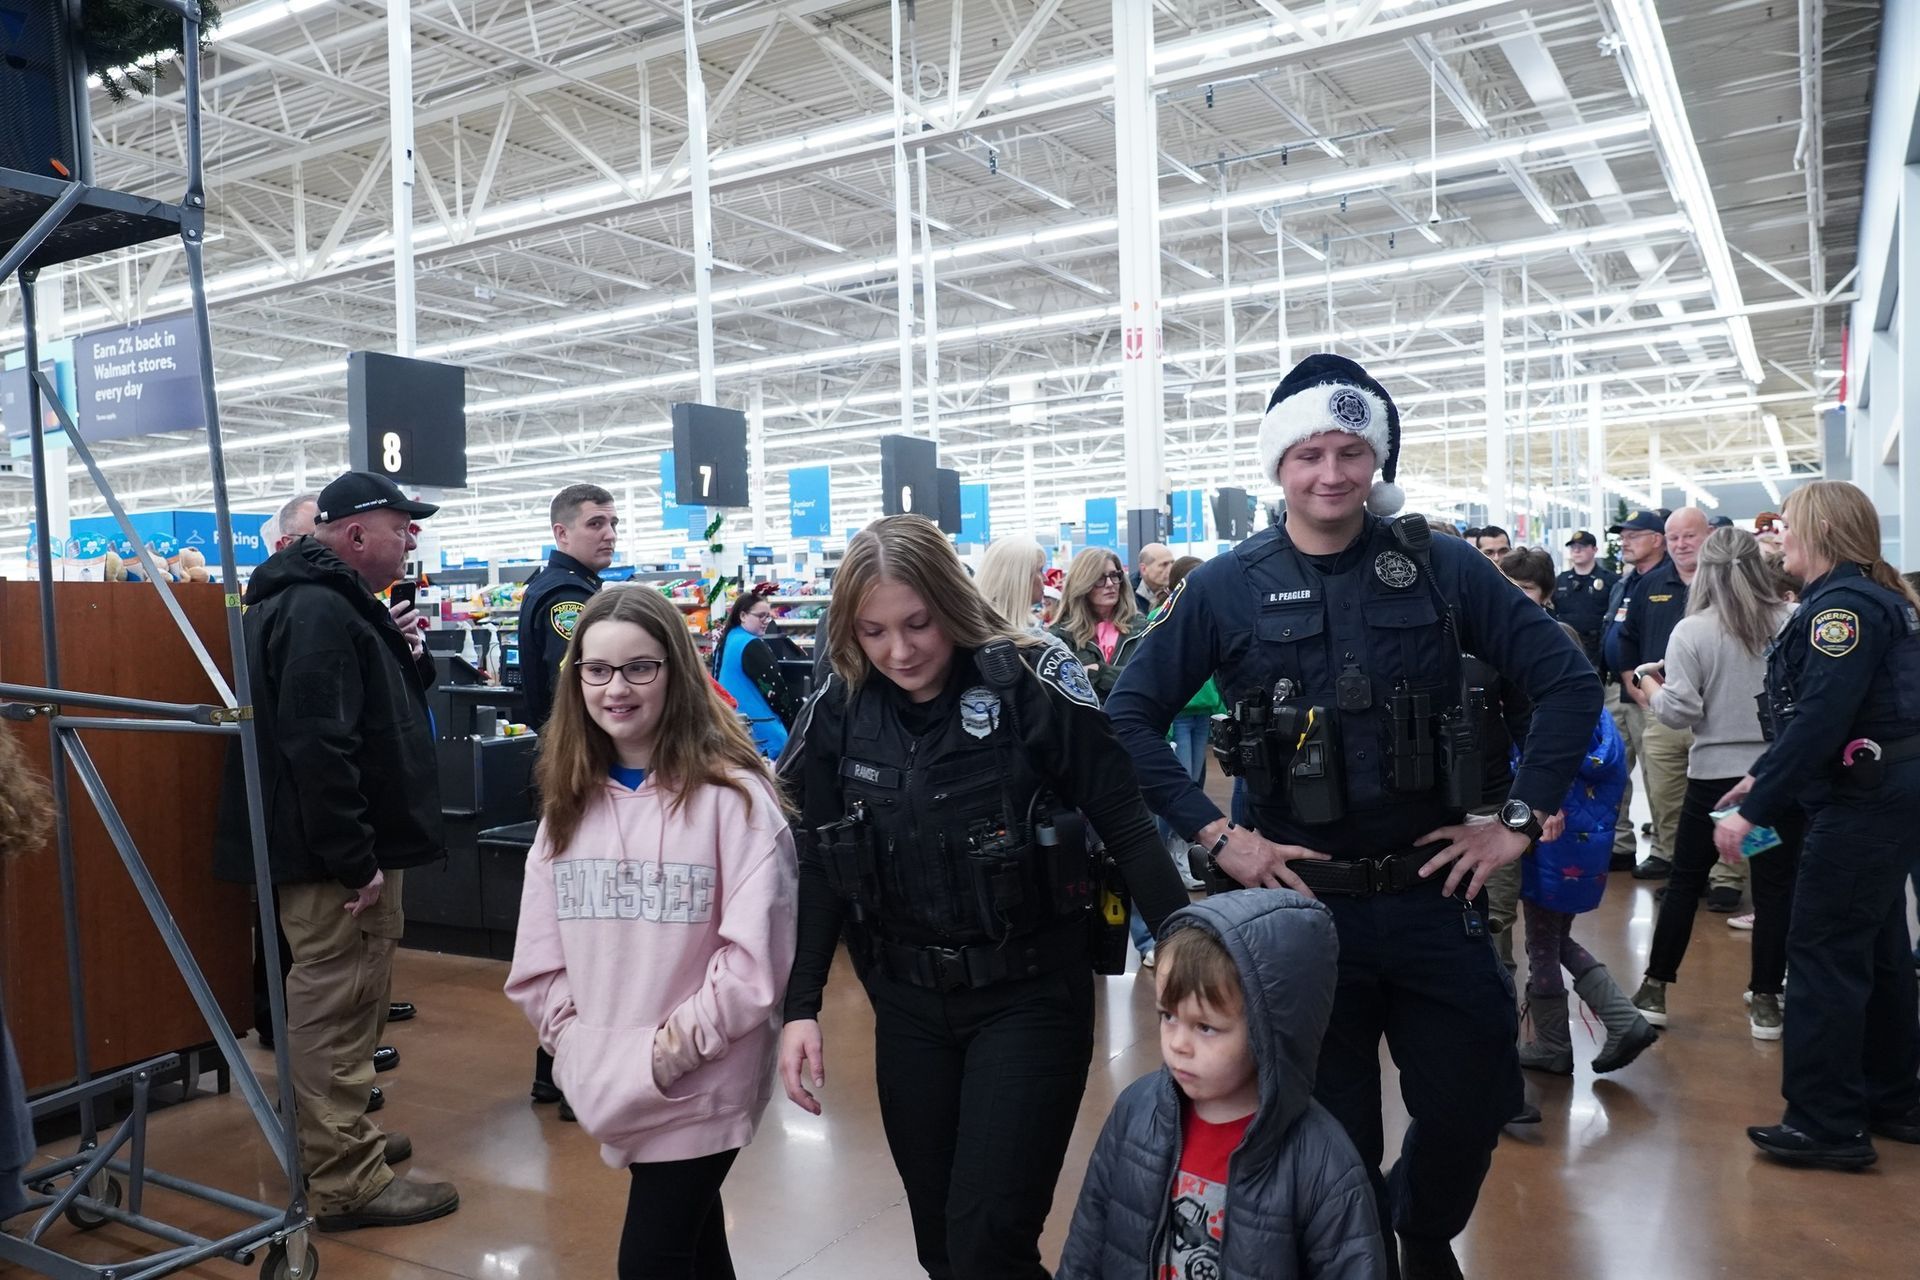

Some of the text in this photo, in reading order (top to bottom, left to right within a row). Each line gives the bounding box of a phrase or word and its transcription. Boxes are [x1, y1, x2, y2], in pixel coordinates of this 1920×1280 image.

[93, 330, 176, 360] Earn 2% back in
[93, 356, 177, 380] Walmart stores,
[95, 380, 143, 403] every day
[383, 431, 402, 473] 8
[699, 465, 712, 497] 7
[901, 485, 912, 513] 6
[1231, 519, 1236, 536] 3
[213, 530, 259, 549] Fting
[1278, 589, 1311, 601] PEAGLER
[1816, 612, 1854, 625] SHERIFF
